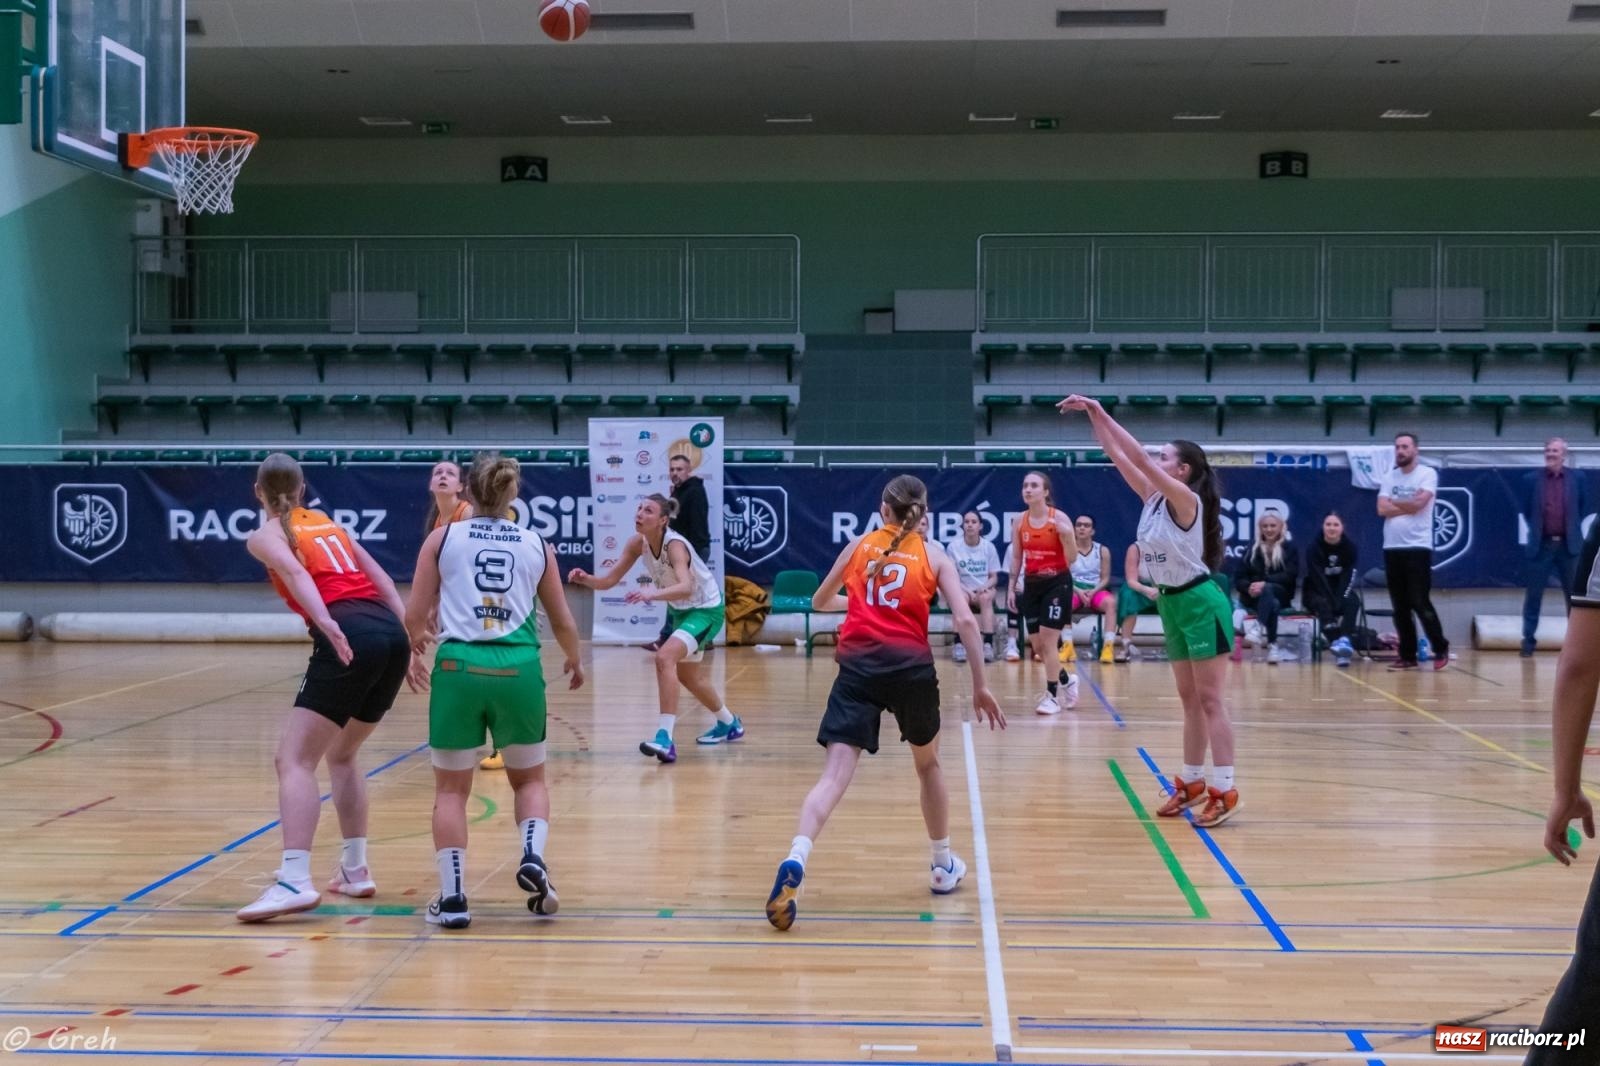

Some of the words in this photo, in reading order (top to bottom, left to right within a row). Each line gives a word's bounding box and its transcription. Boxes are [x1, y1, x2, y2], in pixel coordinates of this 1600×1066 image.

[503, 164, 517, 179] A
[524, 164, 543, 179] A
[1266, 160, 1281, 175] B
[1291, 160, 1304, 174] B
[169, 497, 388, 540] RACIRZ
[468, 531, 522, 543] RACIBÓRZ
[314, 534, 360, 575] 11
[474, 548, 515, 594] 3
[865, 559, 908, 610] 12
[1048, 605, 1062, 620] 13
